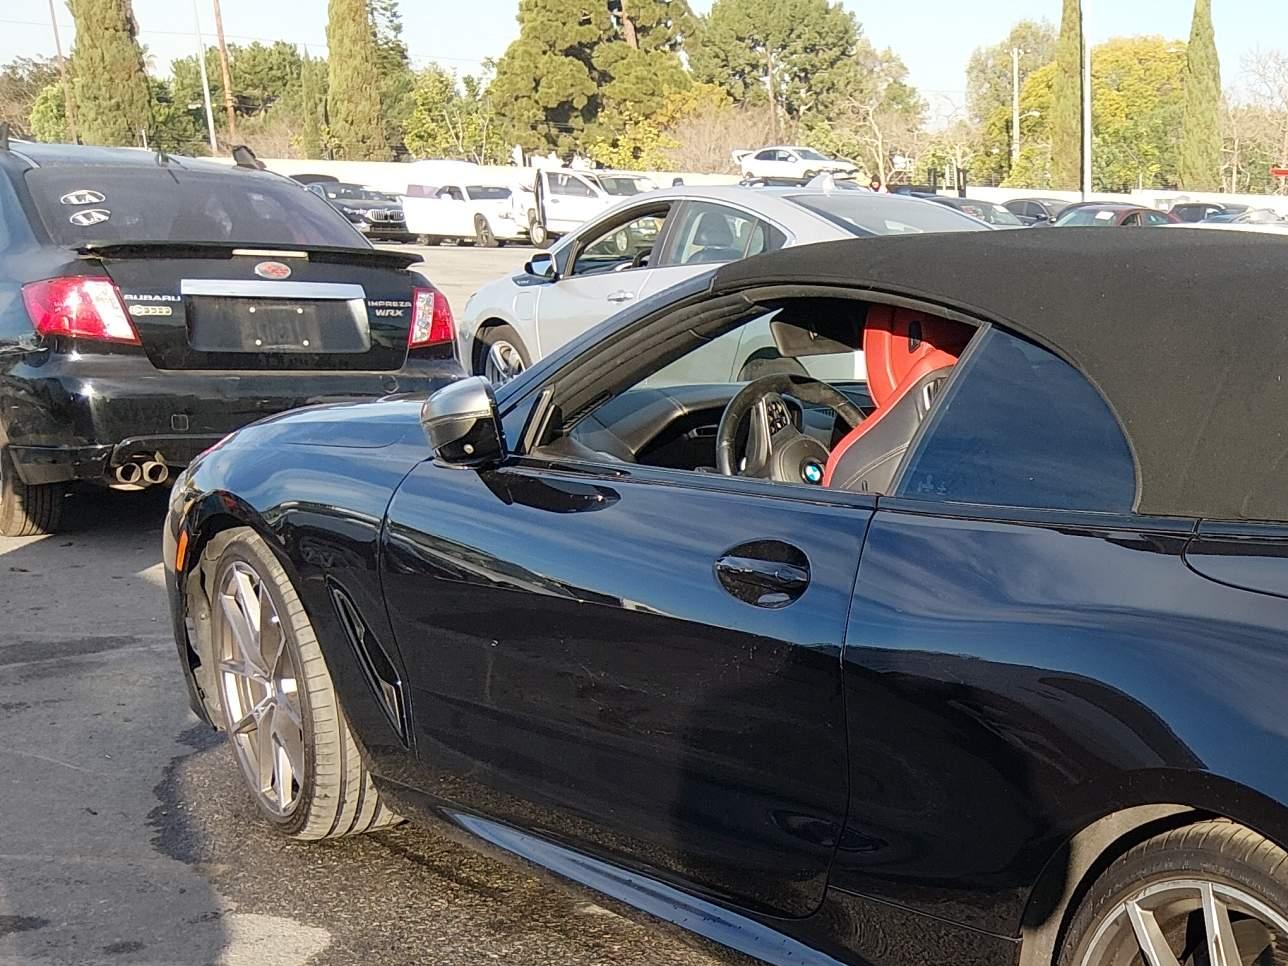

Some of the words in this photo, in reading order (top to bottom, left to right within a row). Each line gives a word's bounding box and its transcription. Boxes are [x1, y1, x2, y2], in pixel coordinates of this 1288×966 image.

[67, 192, 100, 205] LA
[74, 211, 108, 225] LA
[124, 294, 181, 302] SUBARU
[367, 300, 413, 308] IMPREZA
[375, 308, 405, 317] WRX
